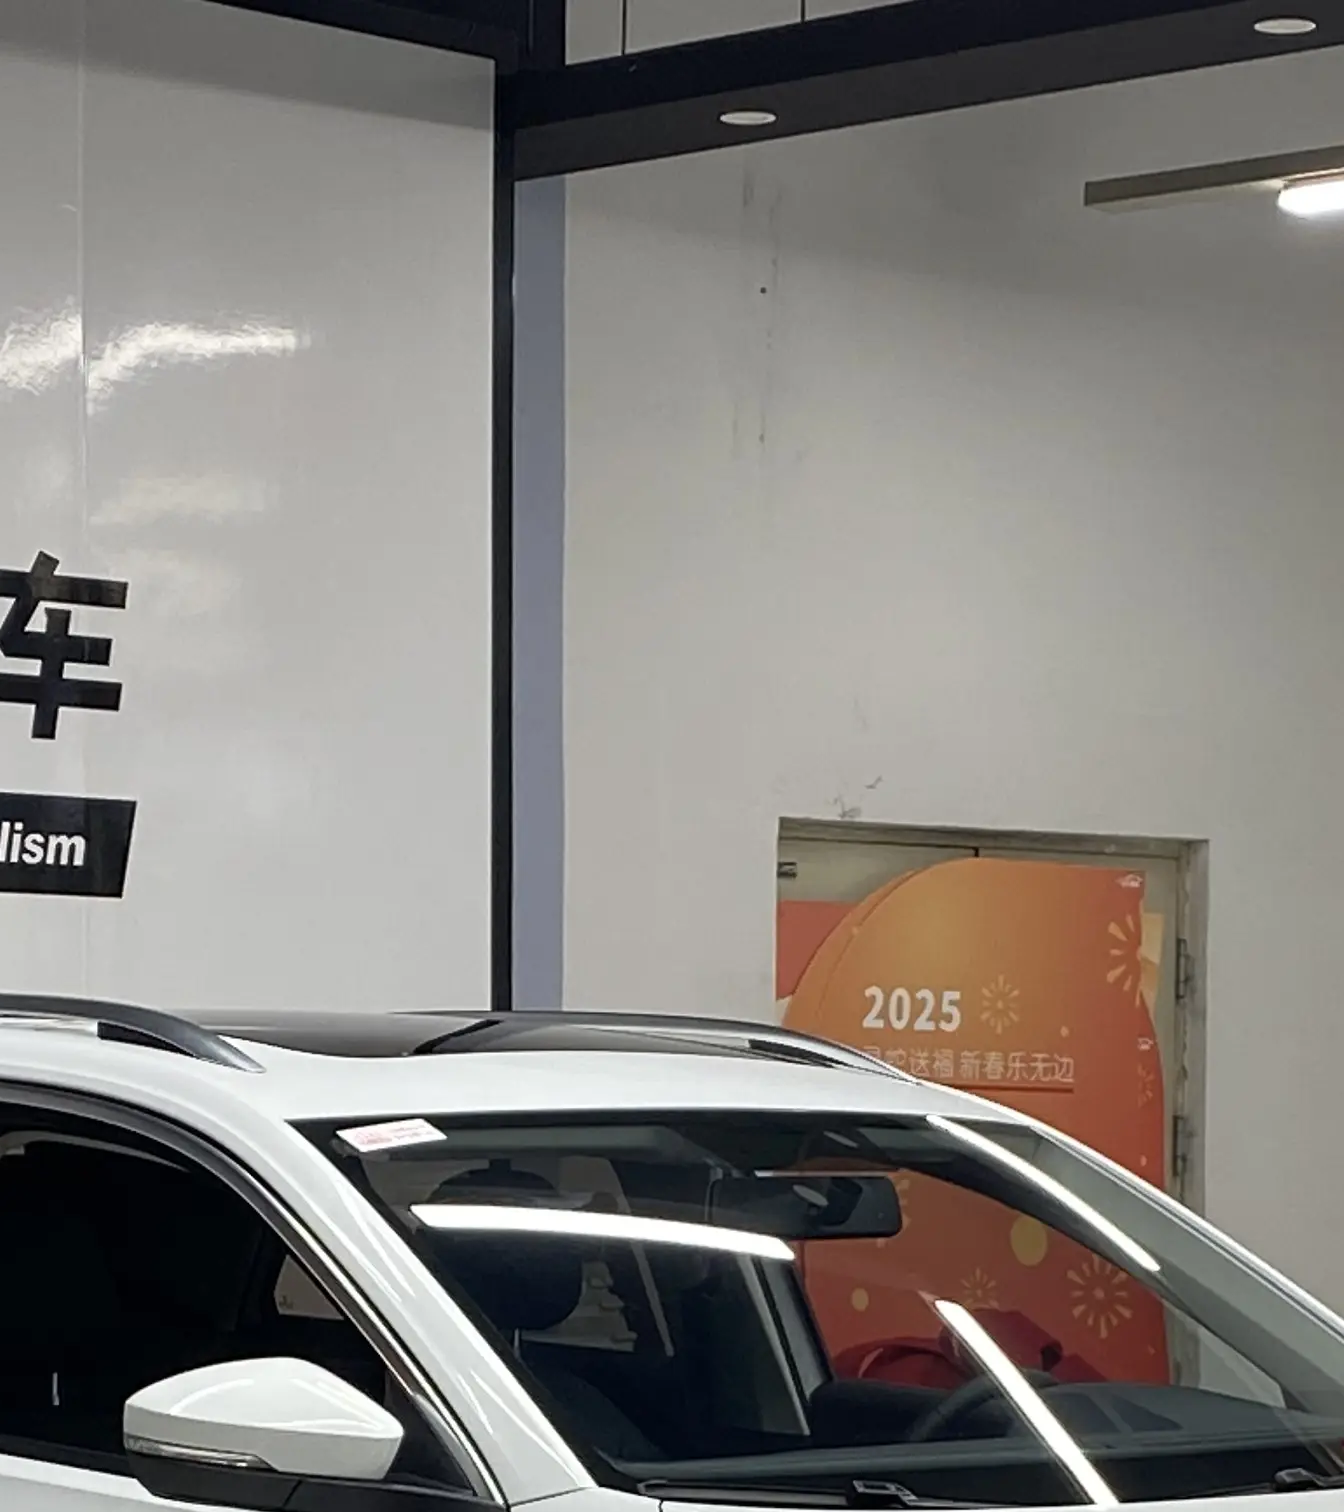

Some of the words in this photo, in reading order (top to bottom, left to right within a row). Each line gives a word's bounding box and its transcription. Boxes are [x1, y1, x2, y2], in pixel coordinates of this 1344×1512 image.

[861, 985, 962, 1032] 2025
[960, 1049, 1075, 1083] 新春乐无边
